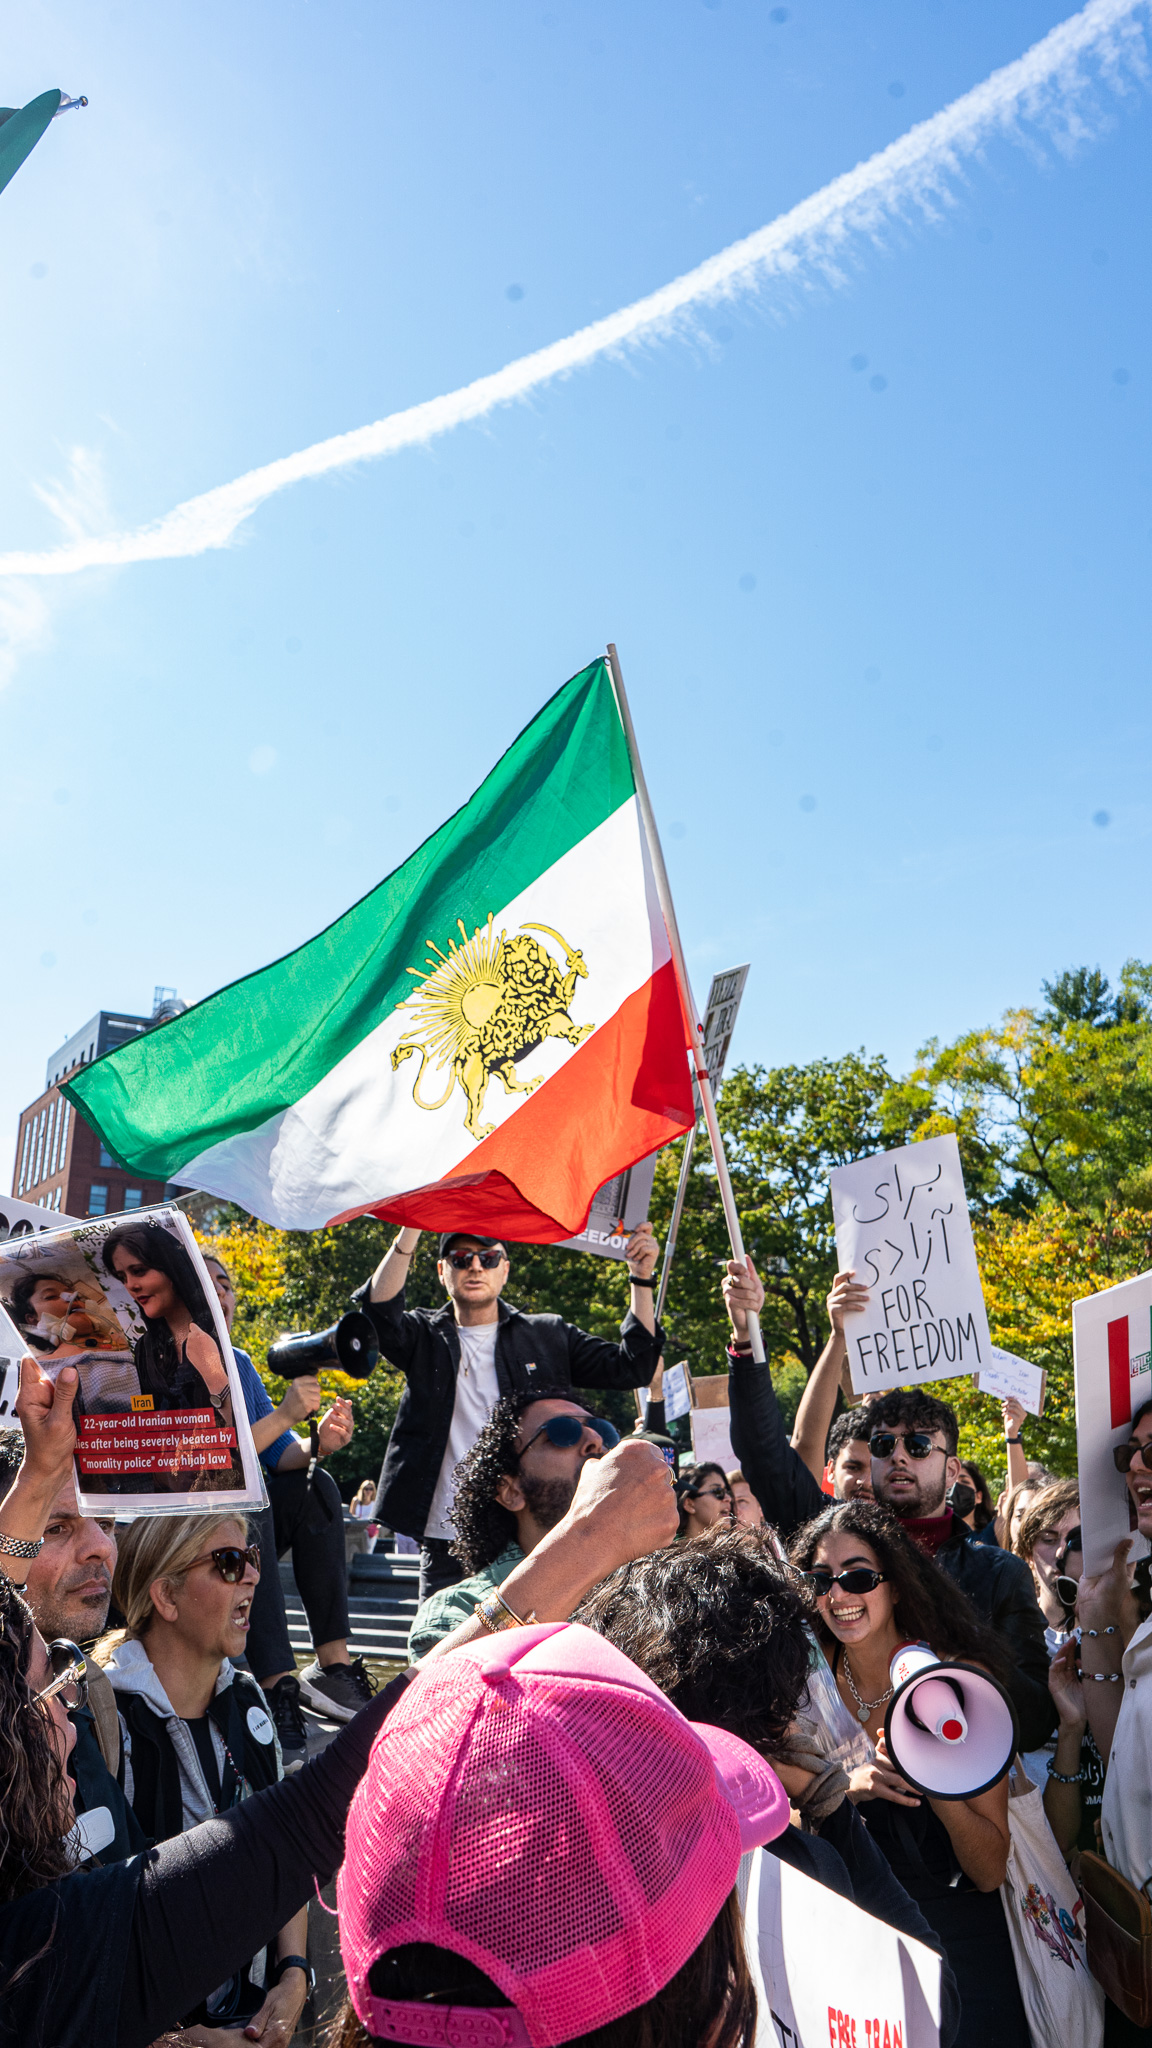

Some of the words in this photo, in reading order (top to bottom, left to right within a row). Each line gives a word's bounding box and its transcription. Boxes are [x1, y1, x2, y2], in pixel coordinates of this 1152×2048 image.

[852, 1163, 942, 1224] برای
[573, 1228, 630, 1251] EEDO
[881, 1279, 934, 1328] FOR
[856, 1312, 982, 1376] FREEDOM
[133, 1397, 151, 1409] Iran
[84, 1415, 136, 1431] 22-year-old
[138, 1416, 172, 1427] Iranian
[174, 1414, 210, 1425] woman
[90, 1439, 112, 1450] after
[113, 1437, 139, 1450] being
[141, 1435, 180, 1447] severely
[182, 1433, 217, 1445] beaten
[219, 1432, 232, 1445] by
[157, 1458, 179, 1467] over
[181, 1455, 206, 1468] hijab
[208, 1453, 226, 1465] law
[828, 2006, 857, 2048] FREE
